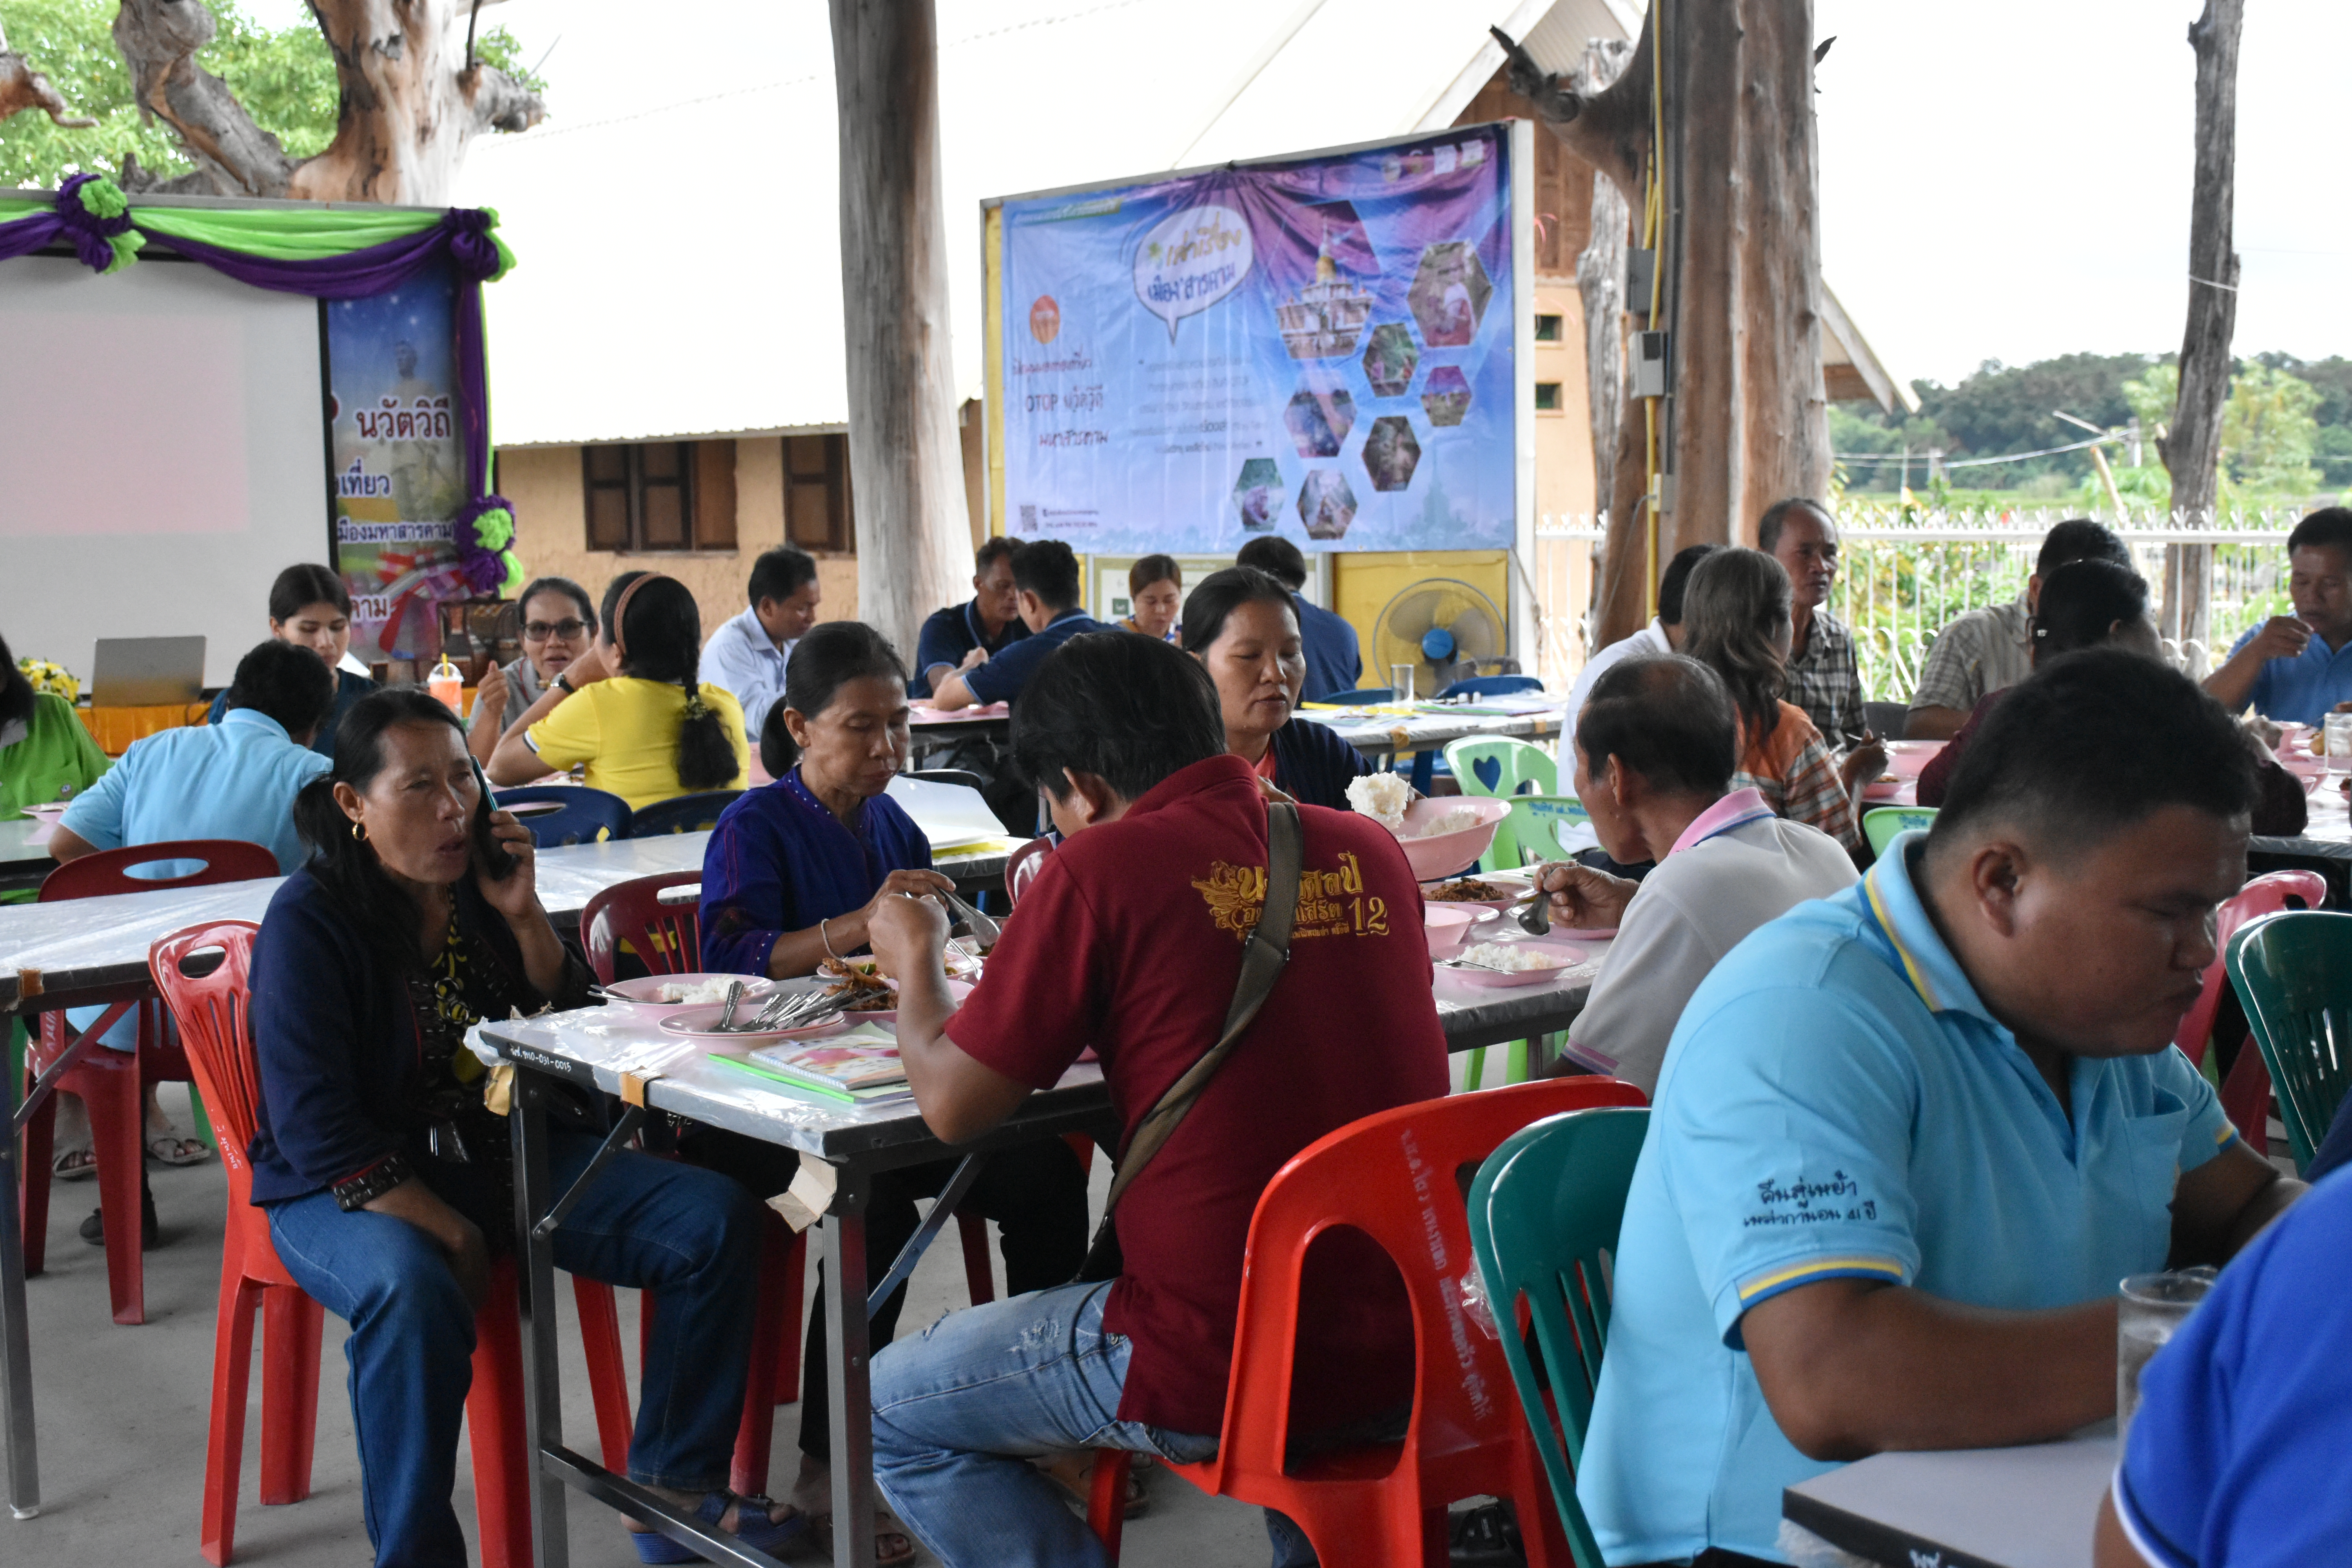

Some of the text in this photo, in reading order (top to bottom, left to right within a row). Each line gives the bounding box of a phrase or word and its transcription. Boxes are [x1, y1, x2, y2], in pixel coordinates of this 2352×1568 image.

[356, 397, 451, 438] นวัตวิถี
[1025, 393, 1058, 412] OTOP
[335, 459, 390, 495] เที่ยว
[1348, 897, 1390, 936] 12
